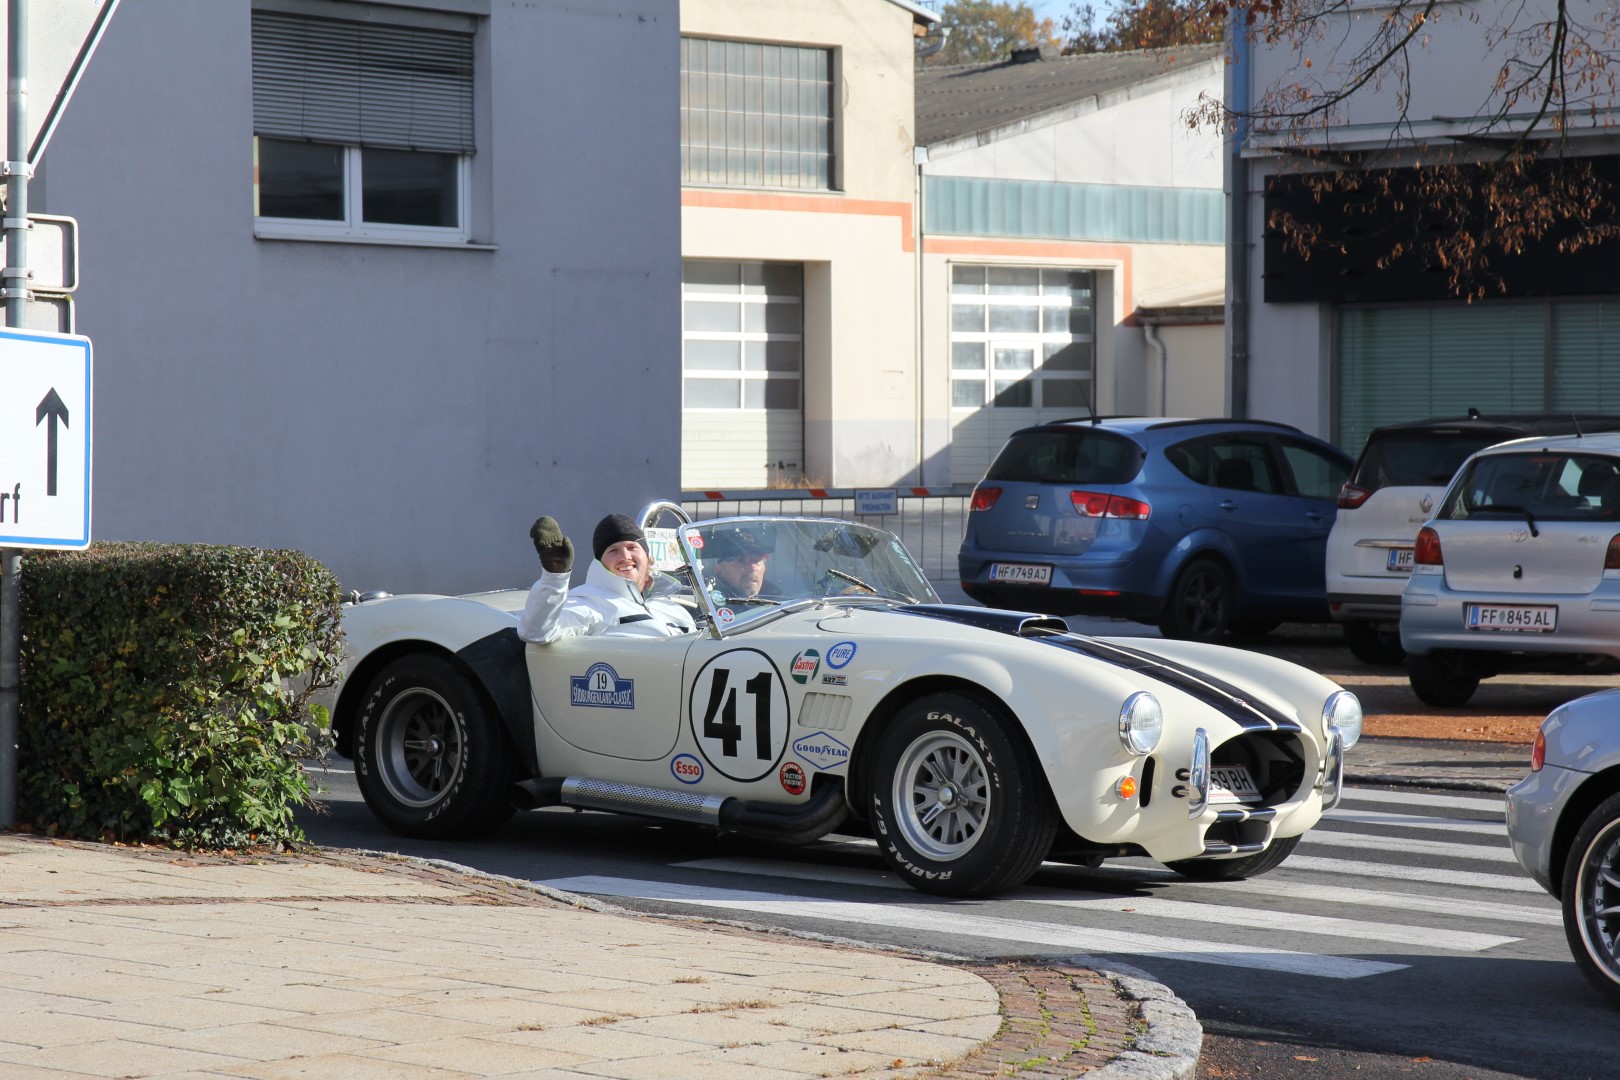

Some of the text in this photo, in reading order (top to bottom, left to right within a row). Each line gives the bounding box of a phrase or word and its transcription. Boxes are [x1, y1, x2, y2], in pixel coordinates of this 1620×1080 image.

[1398, 552, 1413, 564] HF
[998, 566, 1010, 578] HF
[1481, 609, 1498, 624] FF
[831, 648, 851, 659] PURE
[794, 657, 818, 671] Castrol
[596, 672, 608, 690] 19
[704, 668, 772, 761] 41
[358, 685, 383, 776] GALAXY
[926, 711, 996, 767] GALAXY
[888, 841, 953, 880] RADIAL
